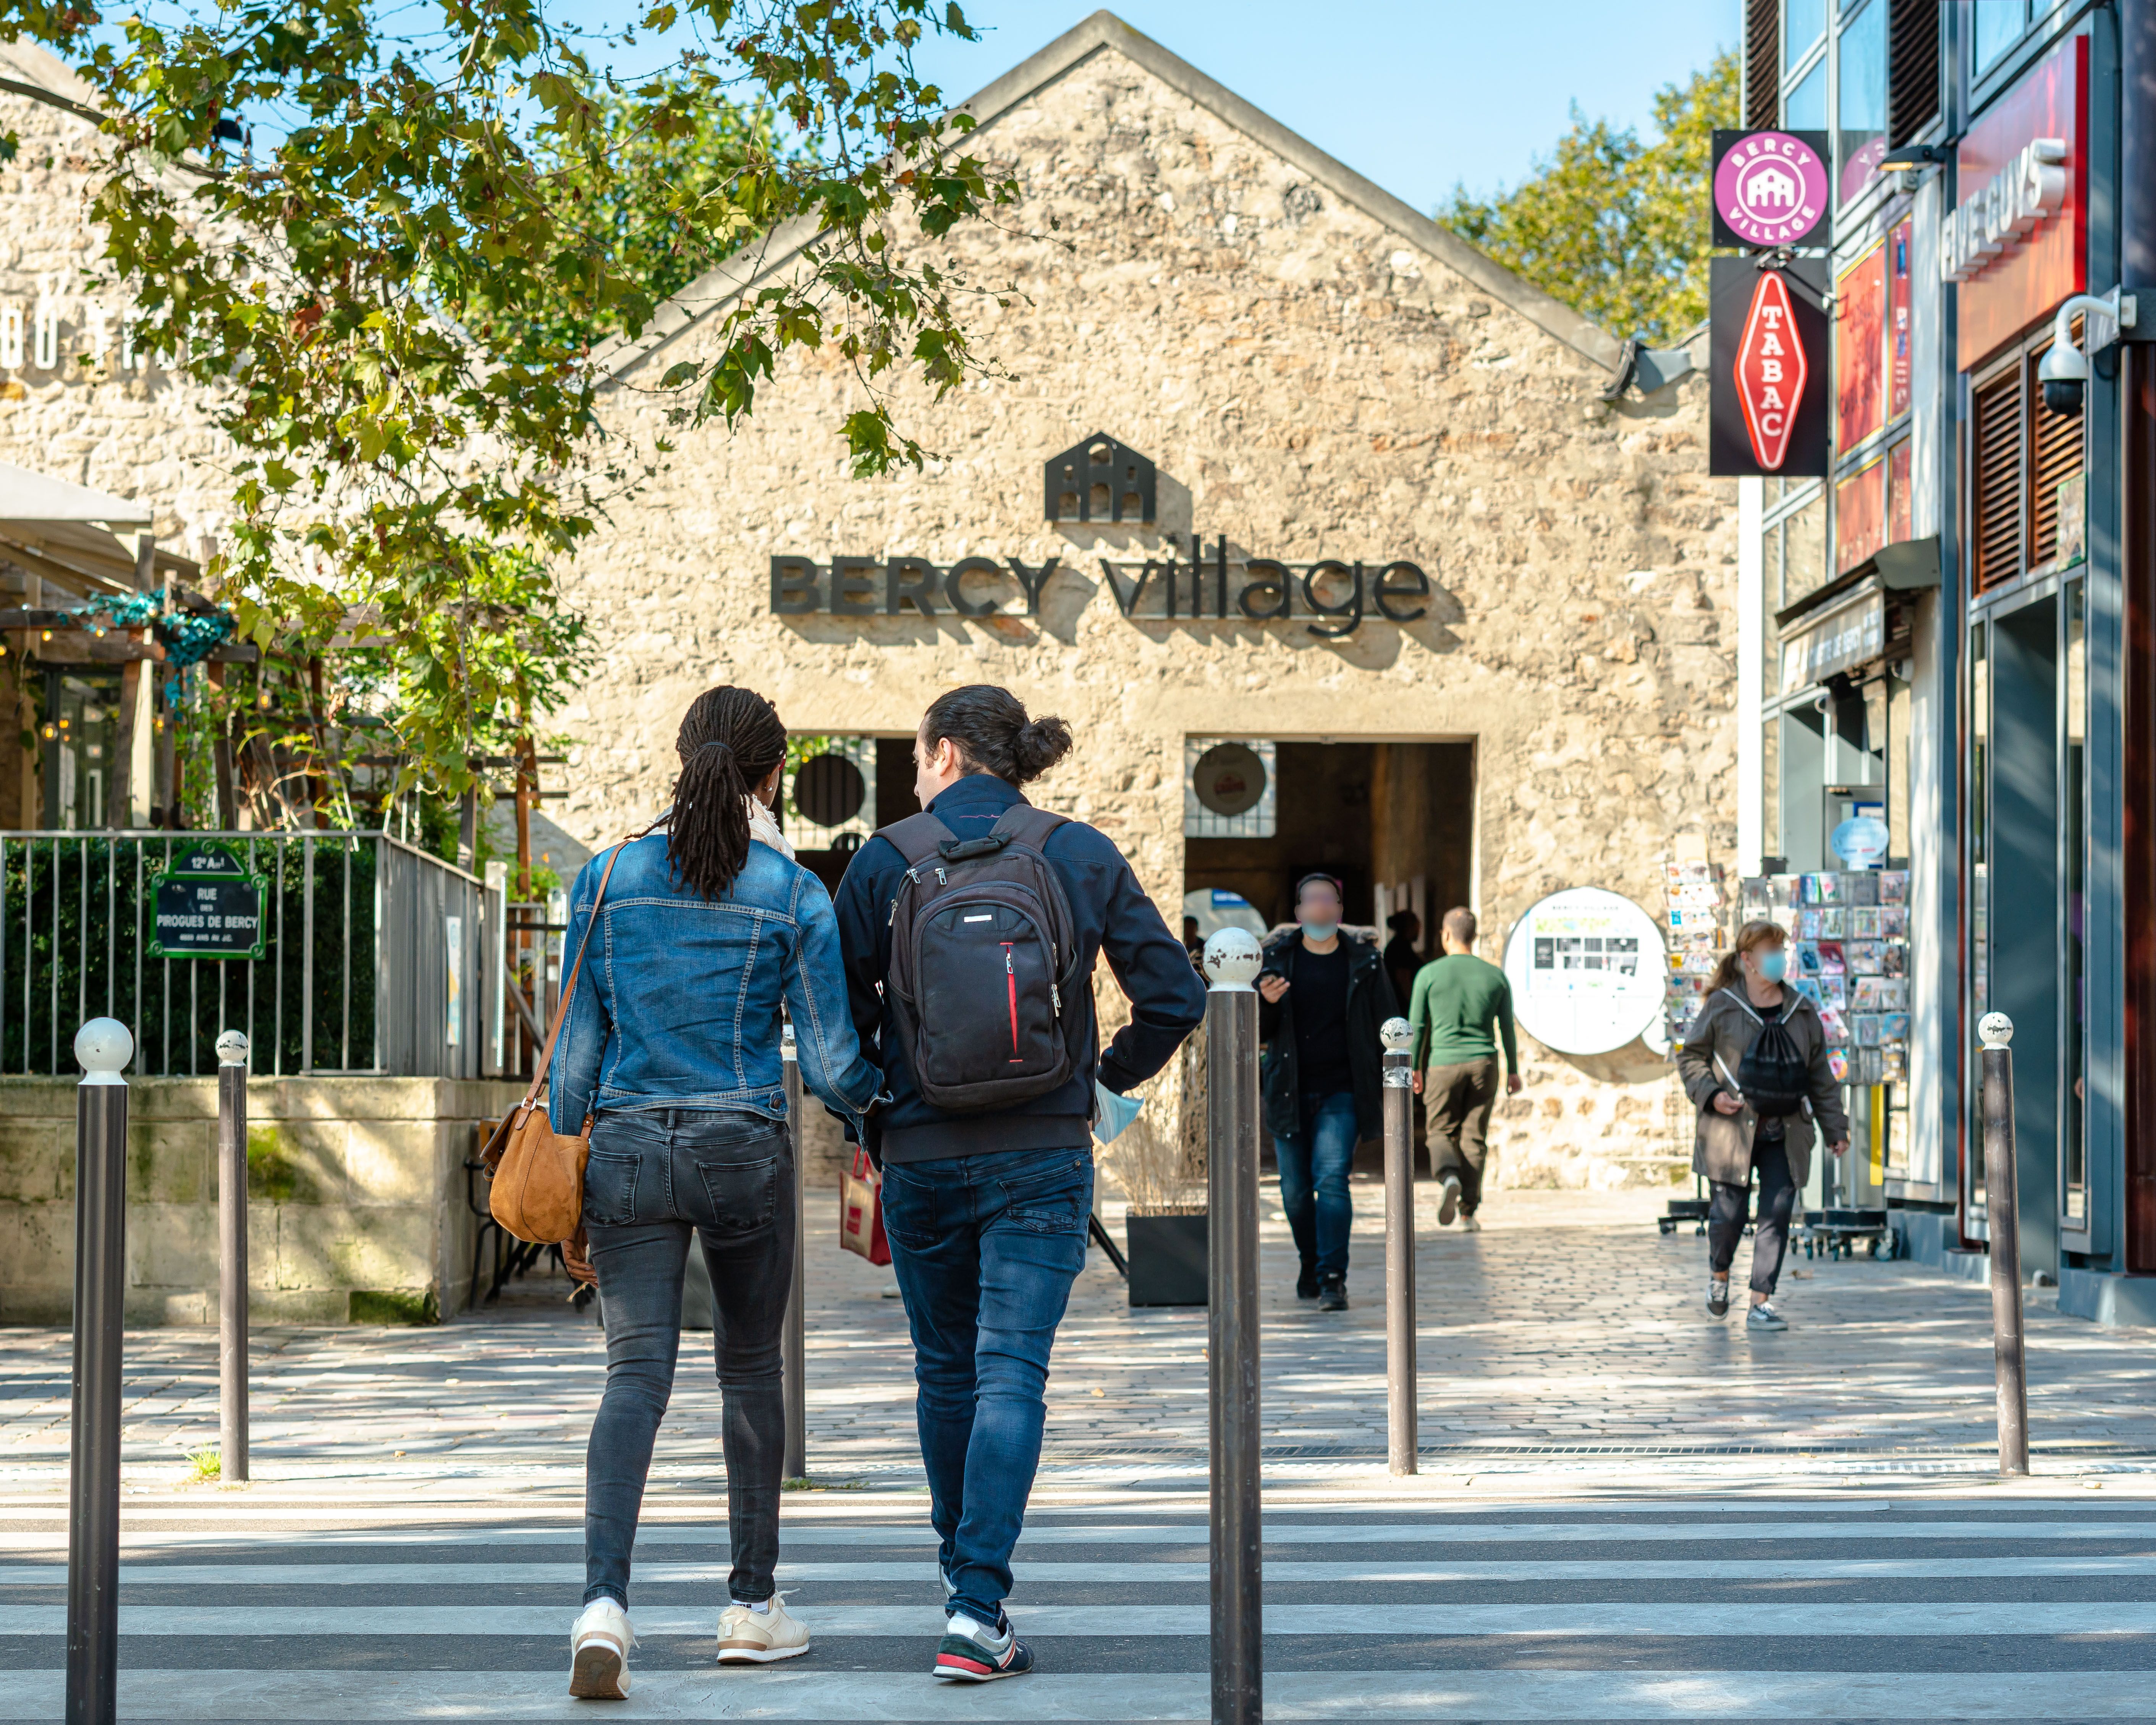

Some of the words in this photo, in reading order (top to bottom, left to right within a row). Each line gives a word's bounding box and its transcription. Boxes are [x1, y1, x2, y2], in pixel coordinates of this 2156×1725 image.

[1730, 138, 1811, 167] BERCY
[1985, 138, 2065, 244] GUYS
[1729, 205, 1816, 240] VILLAGE
[1760, 305, 1785, 437] TABAC
[770, 555, 1061, 615] BERCY
[1098, 534, 1431, 638] village
[197, 887, 217, 901] RUE
[157, 914, 204, 928] PIROGUES
[207, 915, 222, 928] DE
[225, 915, 258, 929] BERCY
